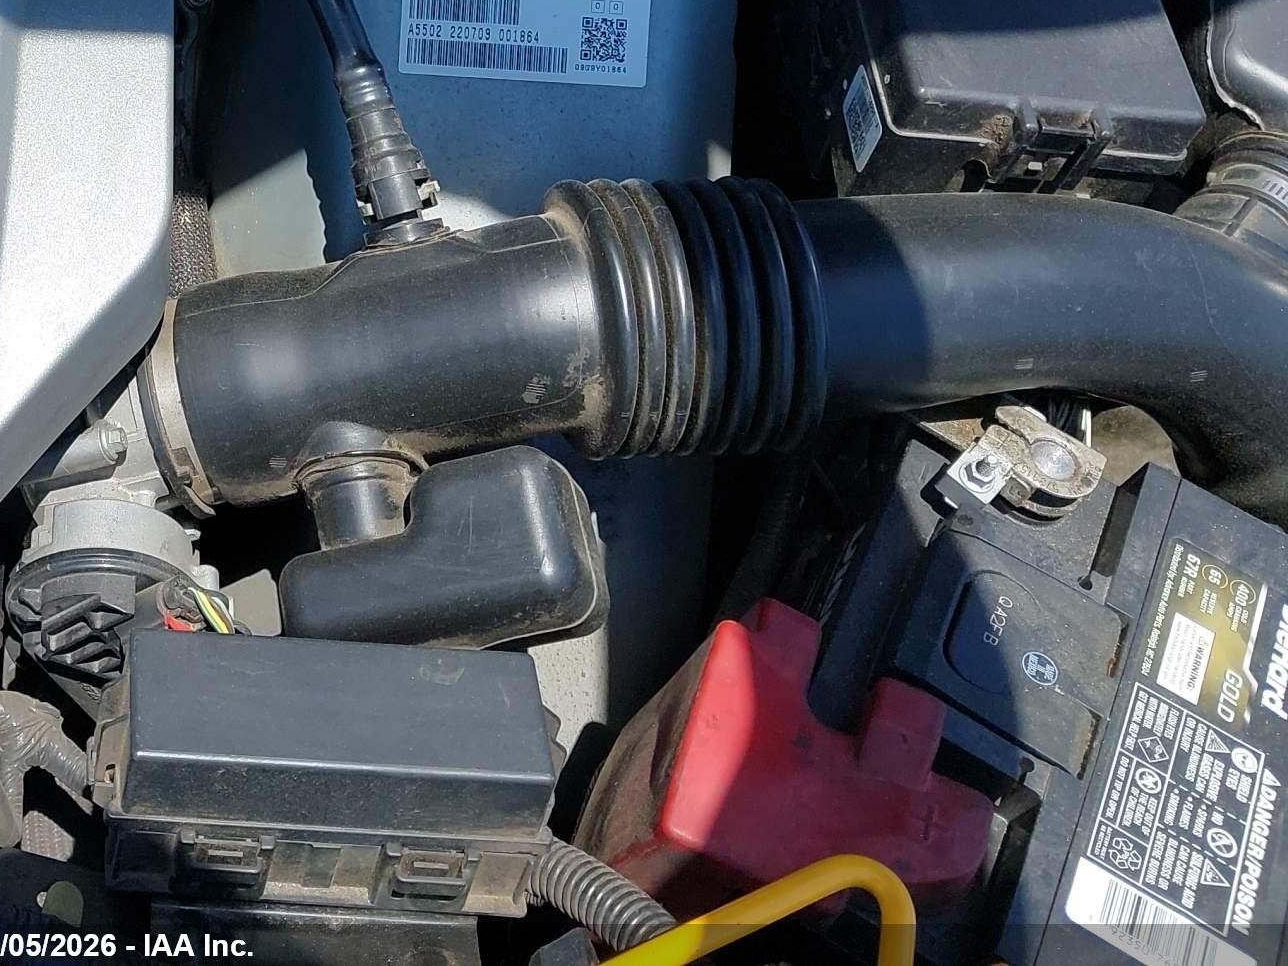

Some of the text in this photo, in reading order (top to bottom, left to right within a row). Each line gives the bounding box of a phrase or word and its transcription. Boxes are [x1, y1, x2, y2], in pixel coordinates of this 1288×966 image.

[408, 23, 540, 44] A5502 220709 001864
[1168, 543, 1183, 572] Distributed
[1184, 554, 1200, 578] 67R
[1161, 578, 1173, 601] Advance
[1208, 569, 1222, 585] 65
[1157, 599, 1168, 613] Auto
[1235, 584, 1250, 606] 400
[1187, 646, 1205, 690] WARNING:
[1137, 690, 1148, 702] GET
[1217, 669, 1243, 723] GOLD
[1131, 700, 1145, 724] MEDICAL
[1163, 708, 1179, 739] FLUSH EYES
[1128, 721, 1139, 737] HELP
[1179, 717, 1196, 752] OR INJURY
[1120, 755, 1128, 767] DO
[1184, 723, 1207, 782] CAUSE BLINDNESS
[1113, 779, 1122, 791] TIP
[1116, 765, 1126, 779] NOT
[1195, 753, 1213, 793] GASES CAN
[1205, 759, 1225, 802] EXPLOSIVE
[1225, 768, 1239, 790] EYES
[1110, 789, 1119, 801] OR
[1130, 786, 1139, 797] OF
[1235, 774, 1252, 803] SHIELD
[1132, 792, 1147, 825] THE REACH
[1140, 796, 1157, 836] KEEP OUT OF
[1163, 792, 1179, 825] SMOKING
[1178, 801, 1193, 829] FLAMES
[1192, 807, 1207, 837] SPARKS
[1211, 811, 1224, 825] NO
[1144, 831, 1166, 884] SEVERE BURNS
[1157, 838, 1178, 890] BLINDNESS OR
[1171, 844, 1190, 885] CAN CAUSE
[1231, 784, 1278, 935] DANGER/POISON
[1181, 851, 1204, 908] SULFURIC ACID
